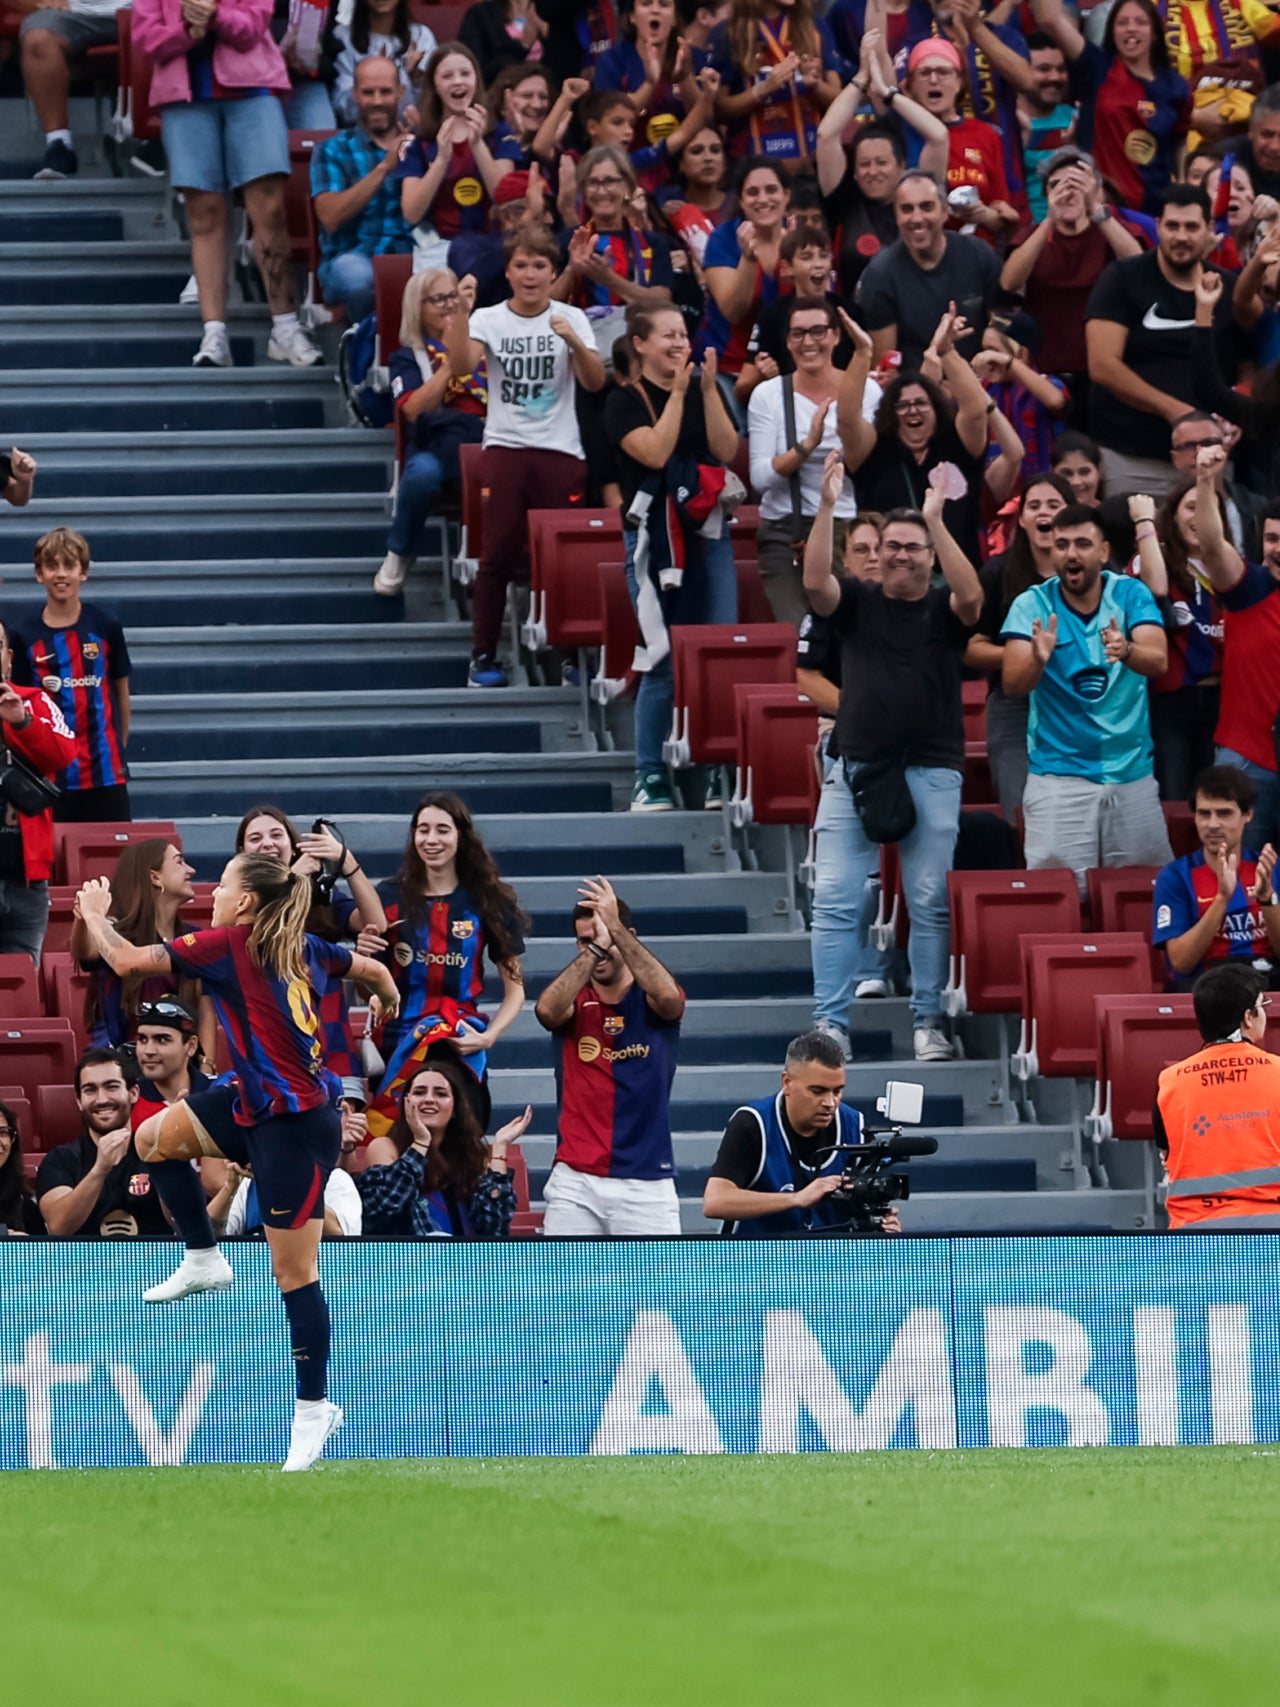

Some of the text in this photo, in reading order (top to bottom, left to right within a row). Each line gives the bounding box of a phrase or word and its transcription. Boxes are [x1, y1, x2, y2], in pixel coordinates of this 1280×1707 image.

[499, 335, 554, 354] JUST BE
[495, 355, 556, 381] YOUR
[62, 675, 102, 688] Spotify
[415, 949, 470, 969] Spotify
[601, 1043, 650, 1065] Spotify
[1210, 1069, 1248, 1086] STW-477
[1, 1331, 216, 1470] tv
